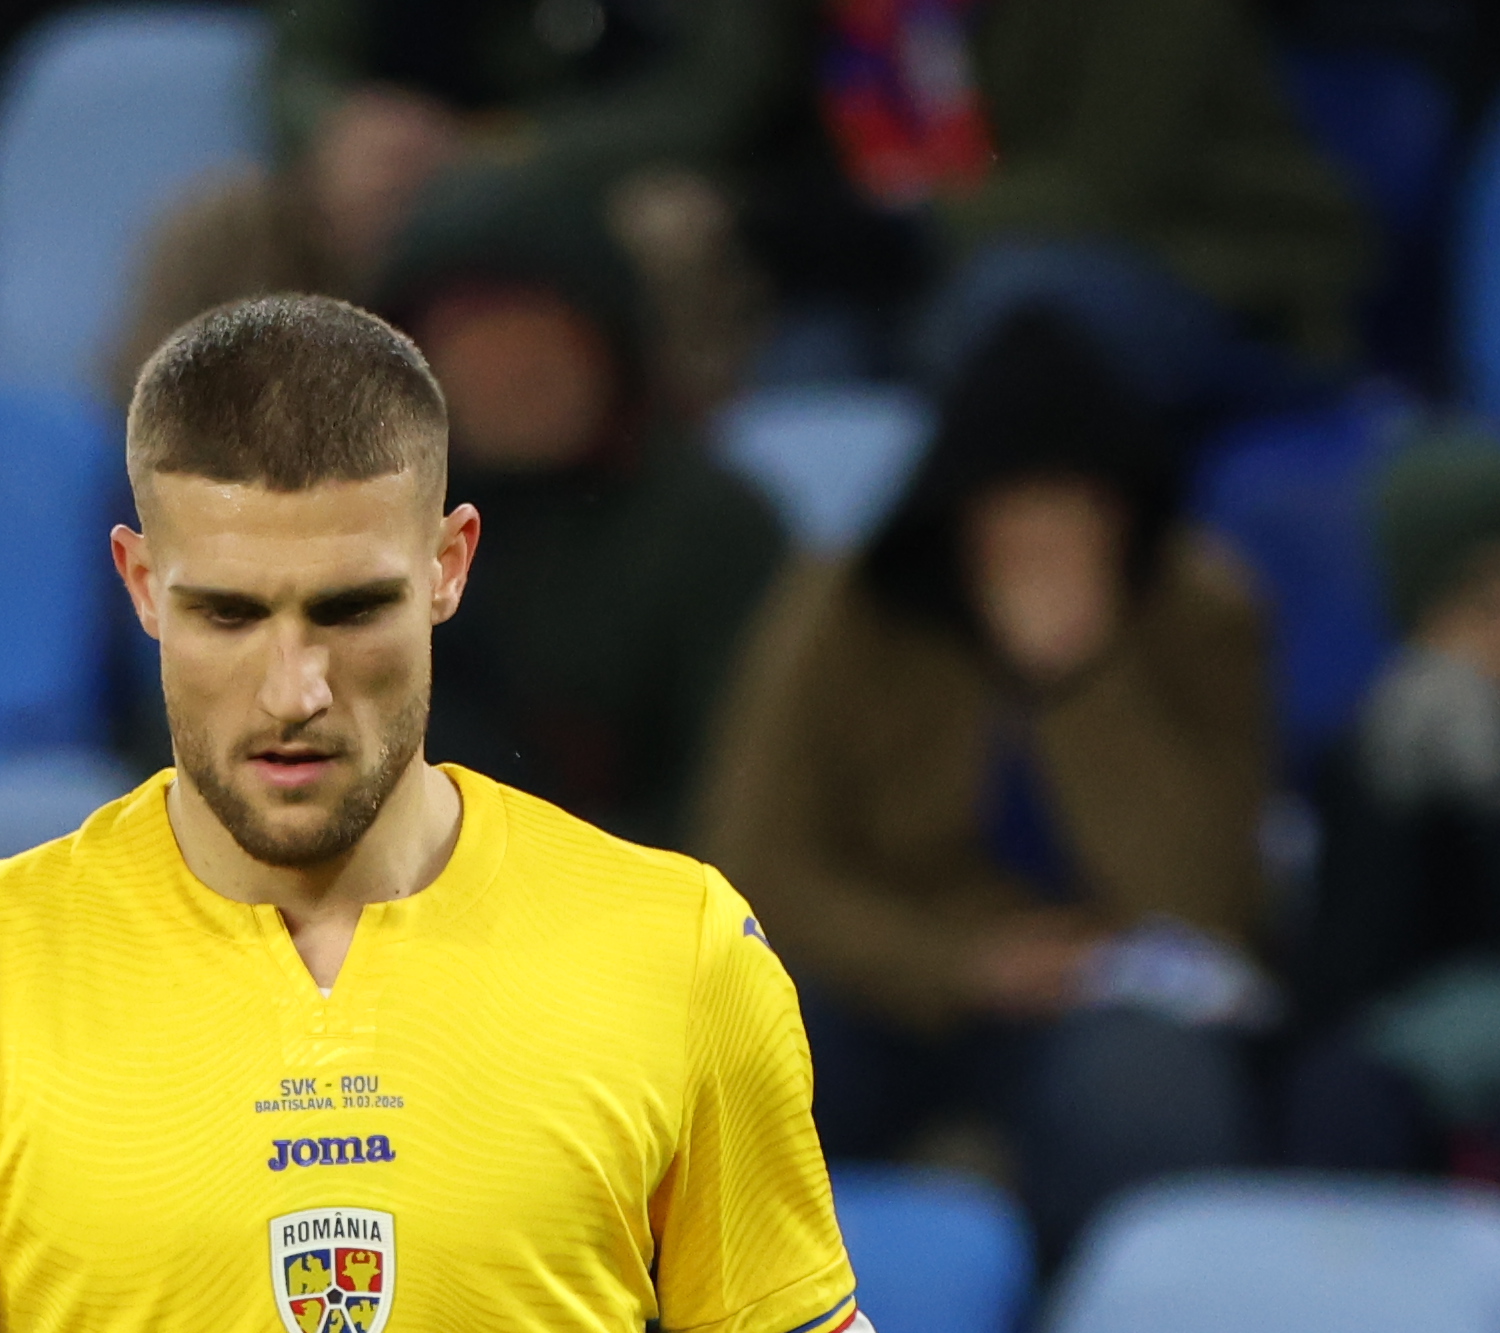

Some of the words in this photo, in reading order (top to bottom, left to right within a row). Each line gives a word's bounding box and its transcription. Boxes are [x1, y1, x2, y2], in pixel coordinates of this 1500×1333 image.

[280, 1078, 317, 1097] SVK
[341, 1075, 379, 1094] ROU
[255, 1097, 337, 1113] BRATISLAVA,
[342, 1095, 404, 1109] 31.03.2026
[283, 1211, 382, 1247] ROMÂNIA
